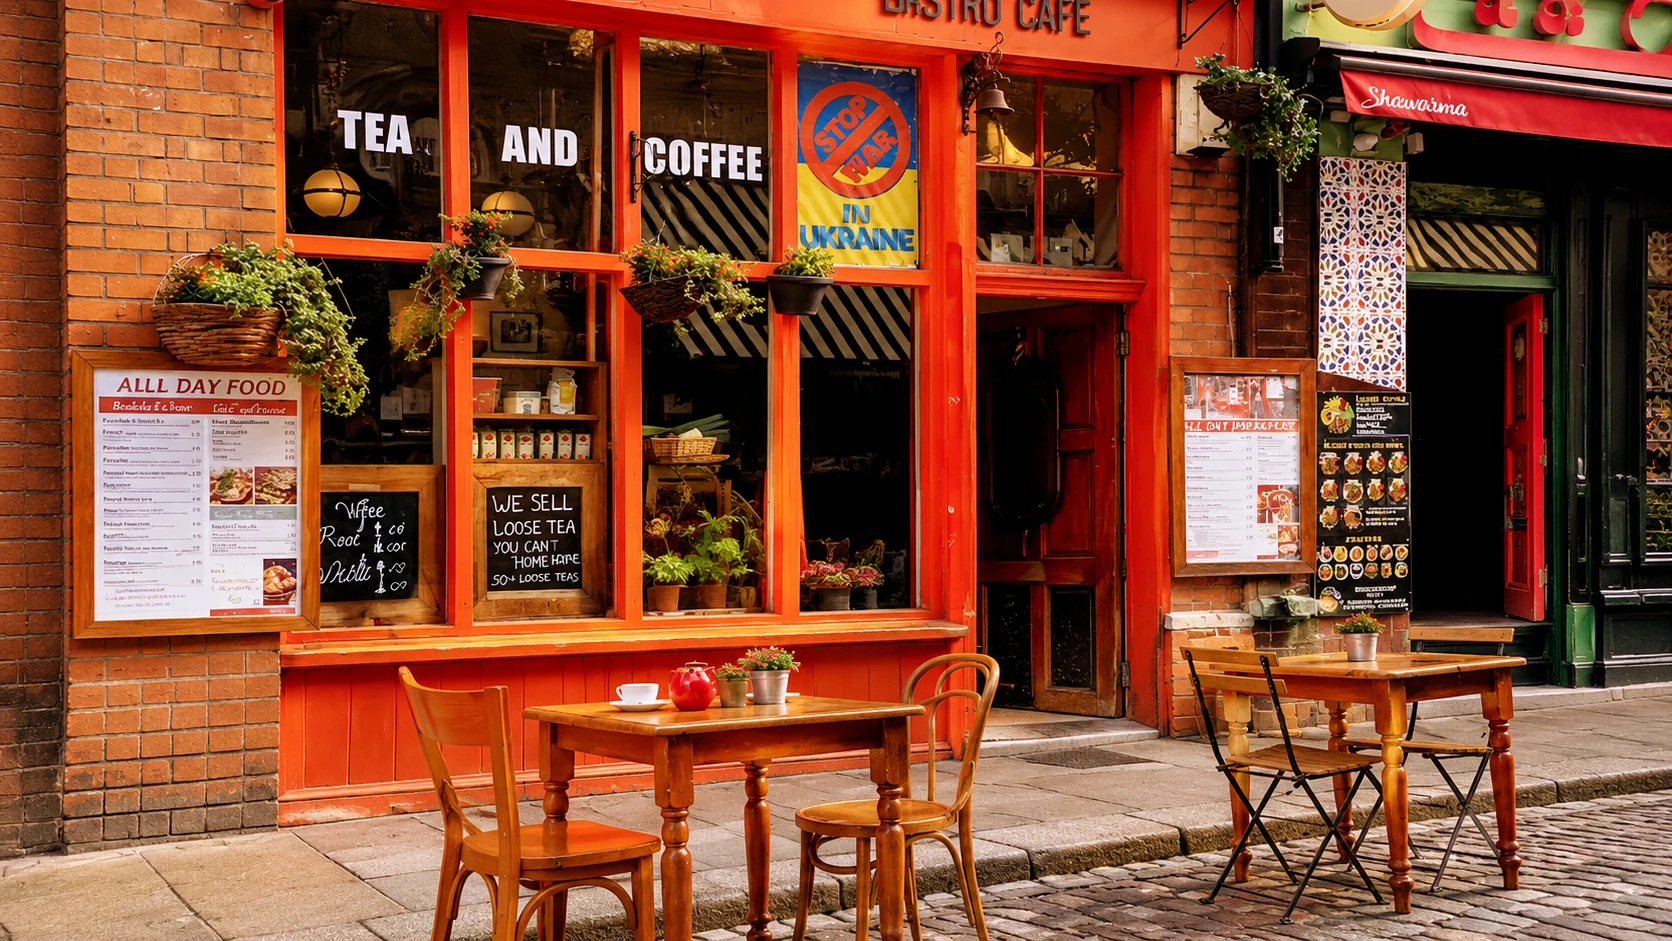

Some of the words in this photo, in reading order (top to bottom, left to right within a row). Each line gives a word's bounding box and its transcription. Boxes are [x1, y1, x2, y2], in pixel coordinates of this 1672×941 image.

[1018, 0, 1090, 35] CAFE
[814, 95, 867, 154] STOP
[337, 110, 413, 155] TEA
[501, 125, 577, 167] AND
[644, 137, 762, 182] COFFEE
[842, 203, 871, 224] IN
[799, 224, 915, 251] UKRAINE
[117, 377, 169, 393] ALLL
[176, 378, 221, 395] DAY
[226, 379, 286, 396] FOOD
[492, 494, 523, 513] WE
[530, 493, 573, 511] SELL
[493, 519, 541, 536] LOOSE
[546, 519, 576, 534] TEA
[493, 541, 519, 555] YOU
[519, 573, 551, 583] LOOSE
[554, 572, 579, 583] TEAS
